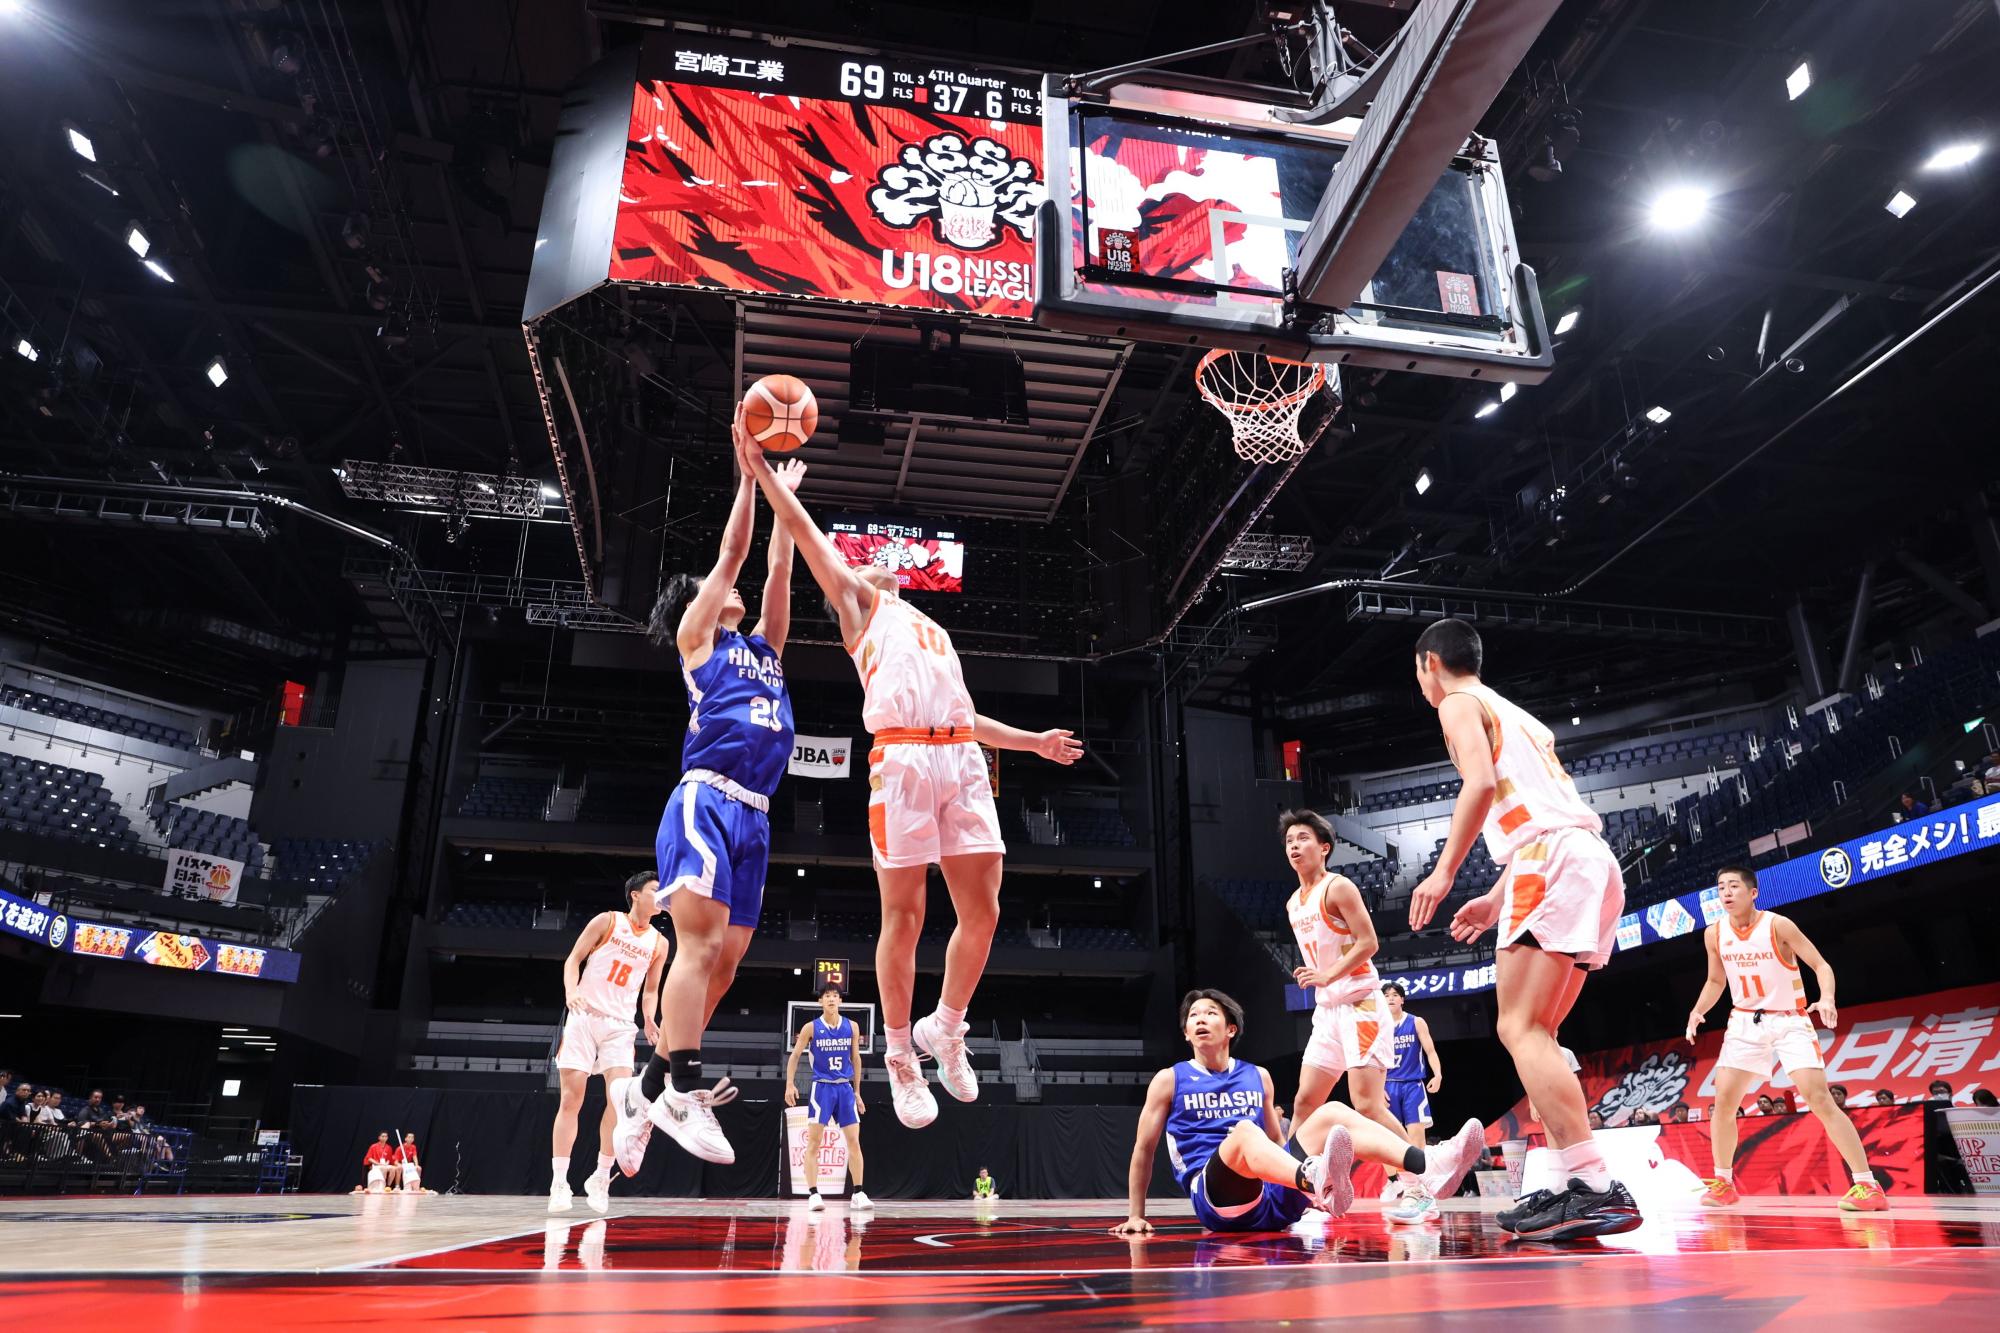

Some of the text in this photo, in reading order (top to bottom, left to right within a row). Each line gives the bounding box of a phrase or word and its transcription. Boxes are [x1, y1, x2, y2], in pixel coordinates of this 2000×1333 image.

[675, 50, 785, 82] 宮崎工業
[840, 61, 885, 100] 69
[893, 71, 925, 86] TOL 3
[928, 69, 1007, 90] 4TH Quarter
[892, 87, 913, 99] FLS
[1011, 87, 1034, 101] TOL
[1011, 102, 1032, 114] FLS
[1107, 248, 1131, 263] U18
[881, 248, 963, 294] U18
[964, 257, 1033, 283] NISSI
[1448, 292, 1471, 306] U18
[867, 523, 878, 535] 69
[912, 526, 923, 539] 51
[911, 622, 946, 656] 10
[793, 746, 831, 765] JBA
[1859, 812, 1970, 875] 完全メシ!
[176, 855, 217, 871] バスケ
[610, 936, 651, 961] MIYAZAKI
[620, 949, 638, 961] TECH
[1721, 951, 1774, 962] MIYAZAKI
[1739, 975, 1766, 999] 11
[816, 1037, 852, 1048] HIGASHI
[828, 1056, 843, 1071] 15
[1183, 1090, 1263, 1111] HIGASHI
[1196, 1106, 1257, 1119] FUKUOKA
